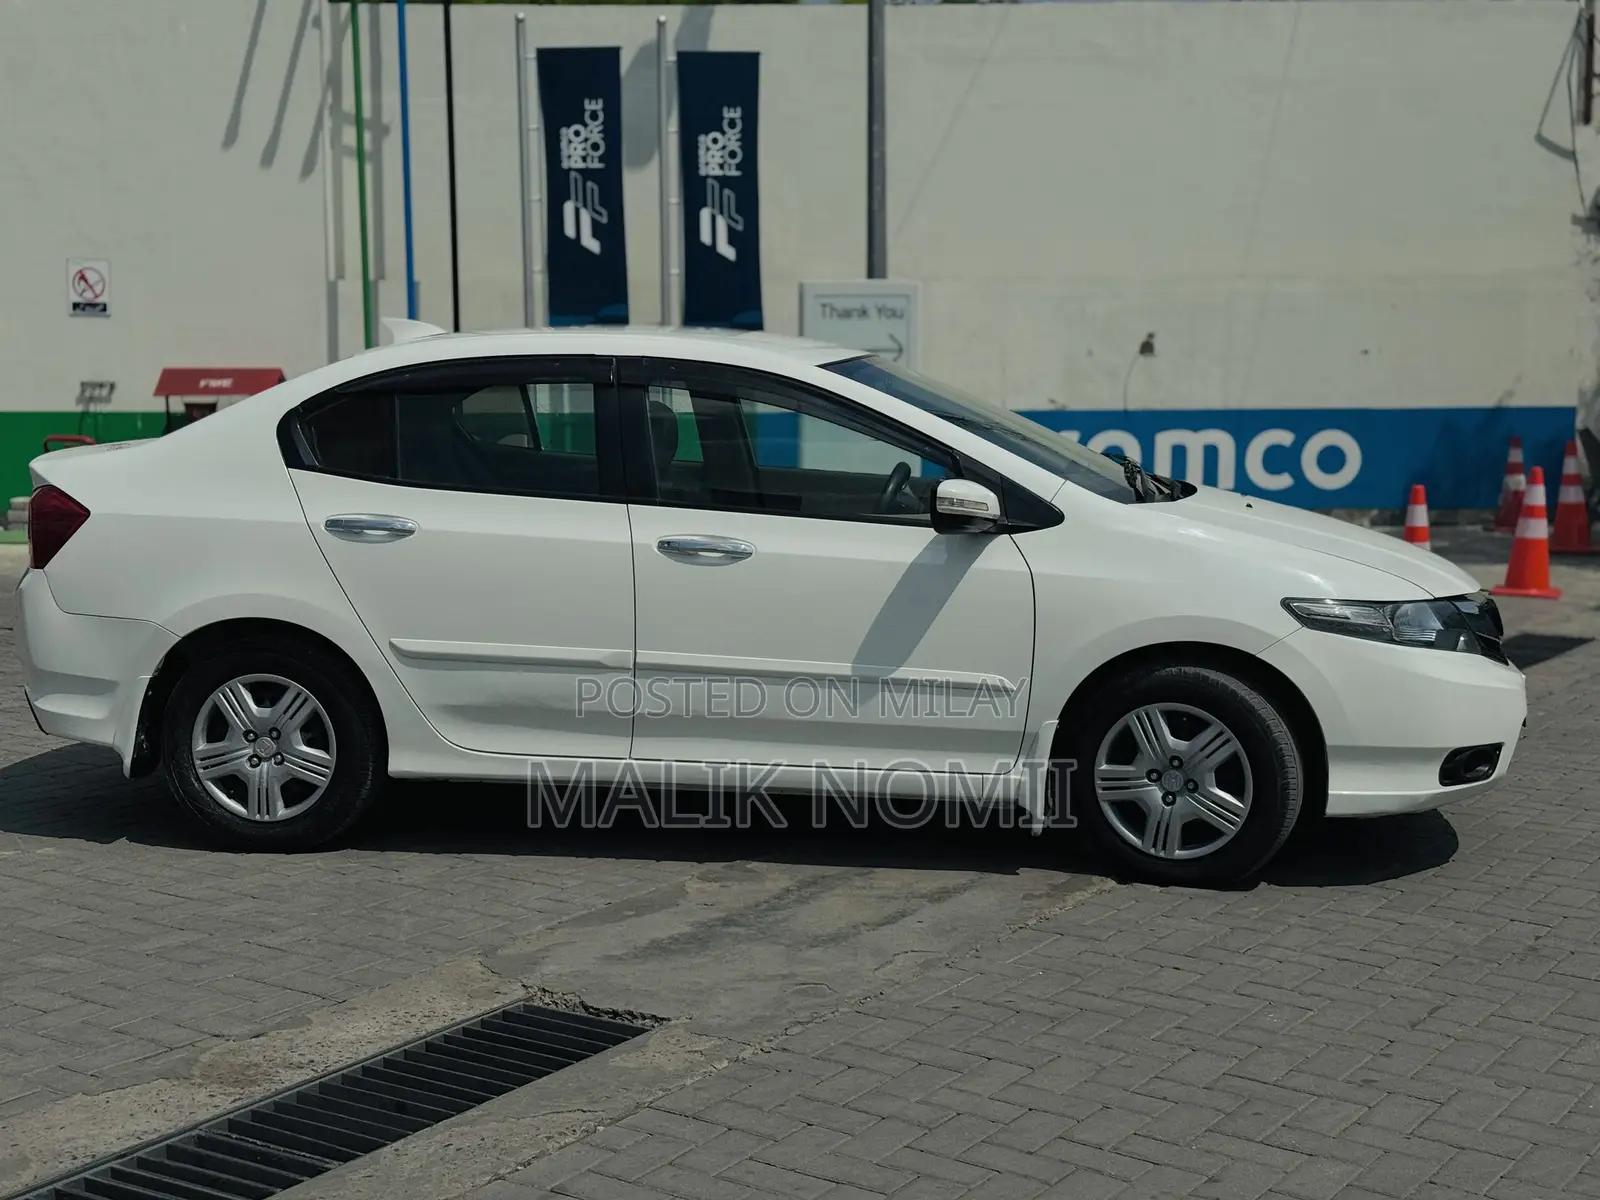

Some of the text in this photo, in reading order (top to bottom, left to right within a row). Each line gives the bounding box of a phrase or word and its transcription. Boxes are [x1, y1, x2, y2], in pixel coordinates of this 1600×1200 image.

[567, 124, 586, 169] PRO
[584, 98, 605, 169] FORCE
[706, 131, 724, 176] PRO
[722, 106, 743, 176] FORCE
[820, 302, 904, 321] Thank You
